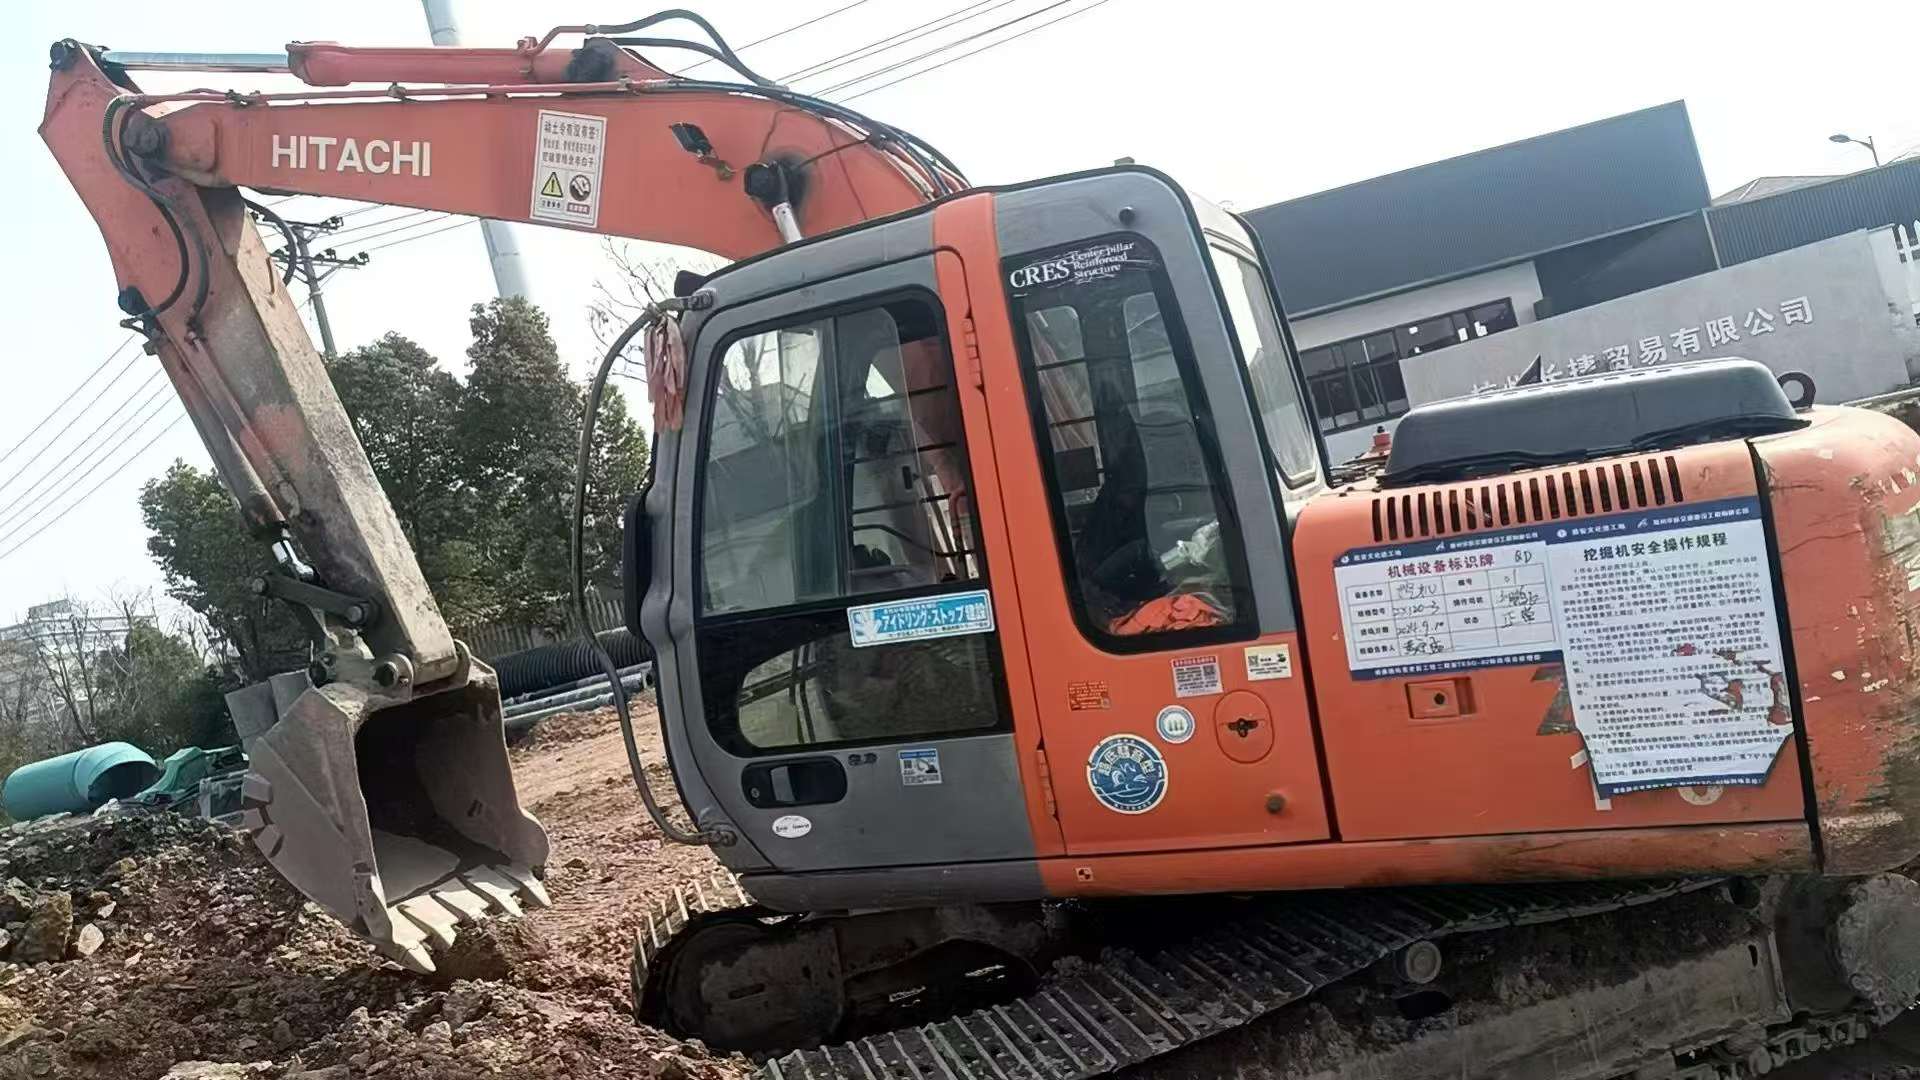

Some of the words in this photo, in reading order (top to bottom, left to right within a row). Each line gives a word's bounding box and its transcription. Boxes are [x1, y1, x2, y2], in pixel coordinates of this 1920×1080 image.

[272, 134, 431, 176] HITACHI
[1010, 257, 1070, 288] CRES
[1073, 252, 1128, 270] Reinforced
[1470, 296, 1814, 395] 长捷贸易有限公司
[1583, 532, 1729, 561] 挖掘机安全操作规程
[1388, 553, 1495, 578] 机械设备标识牌
